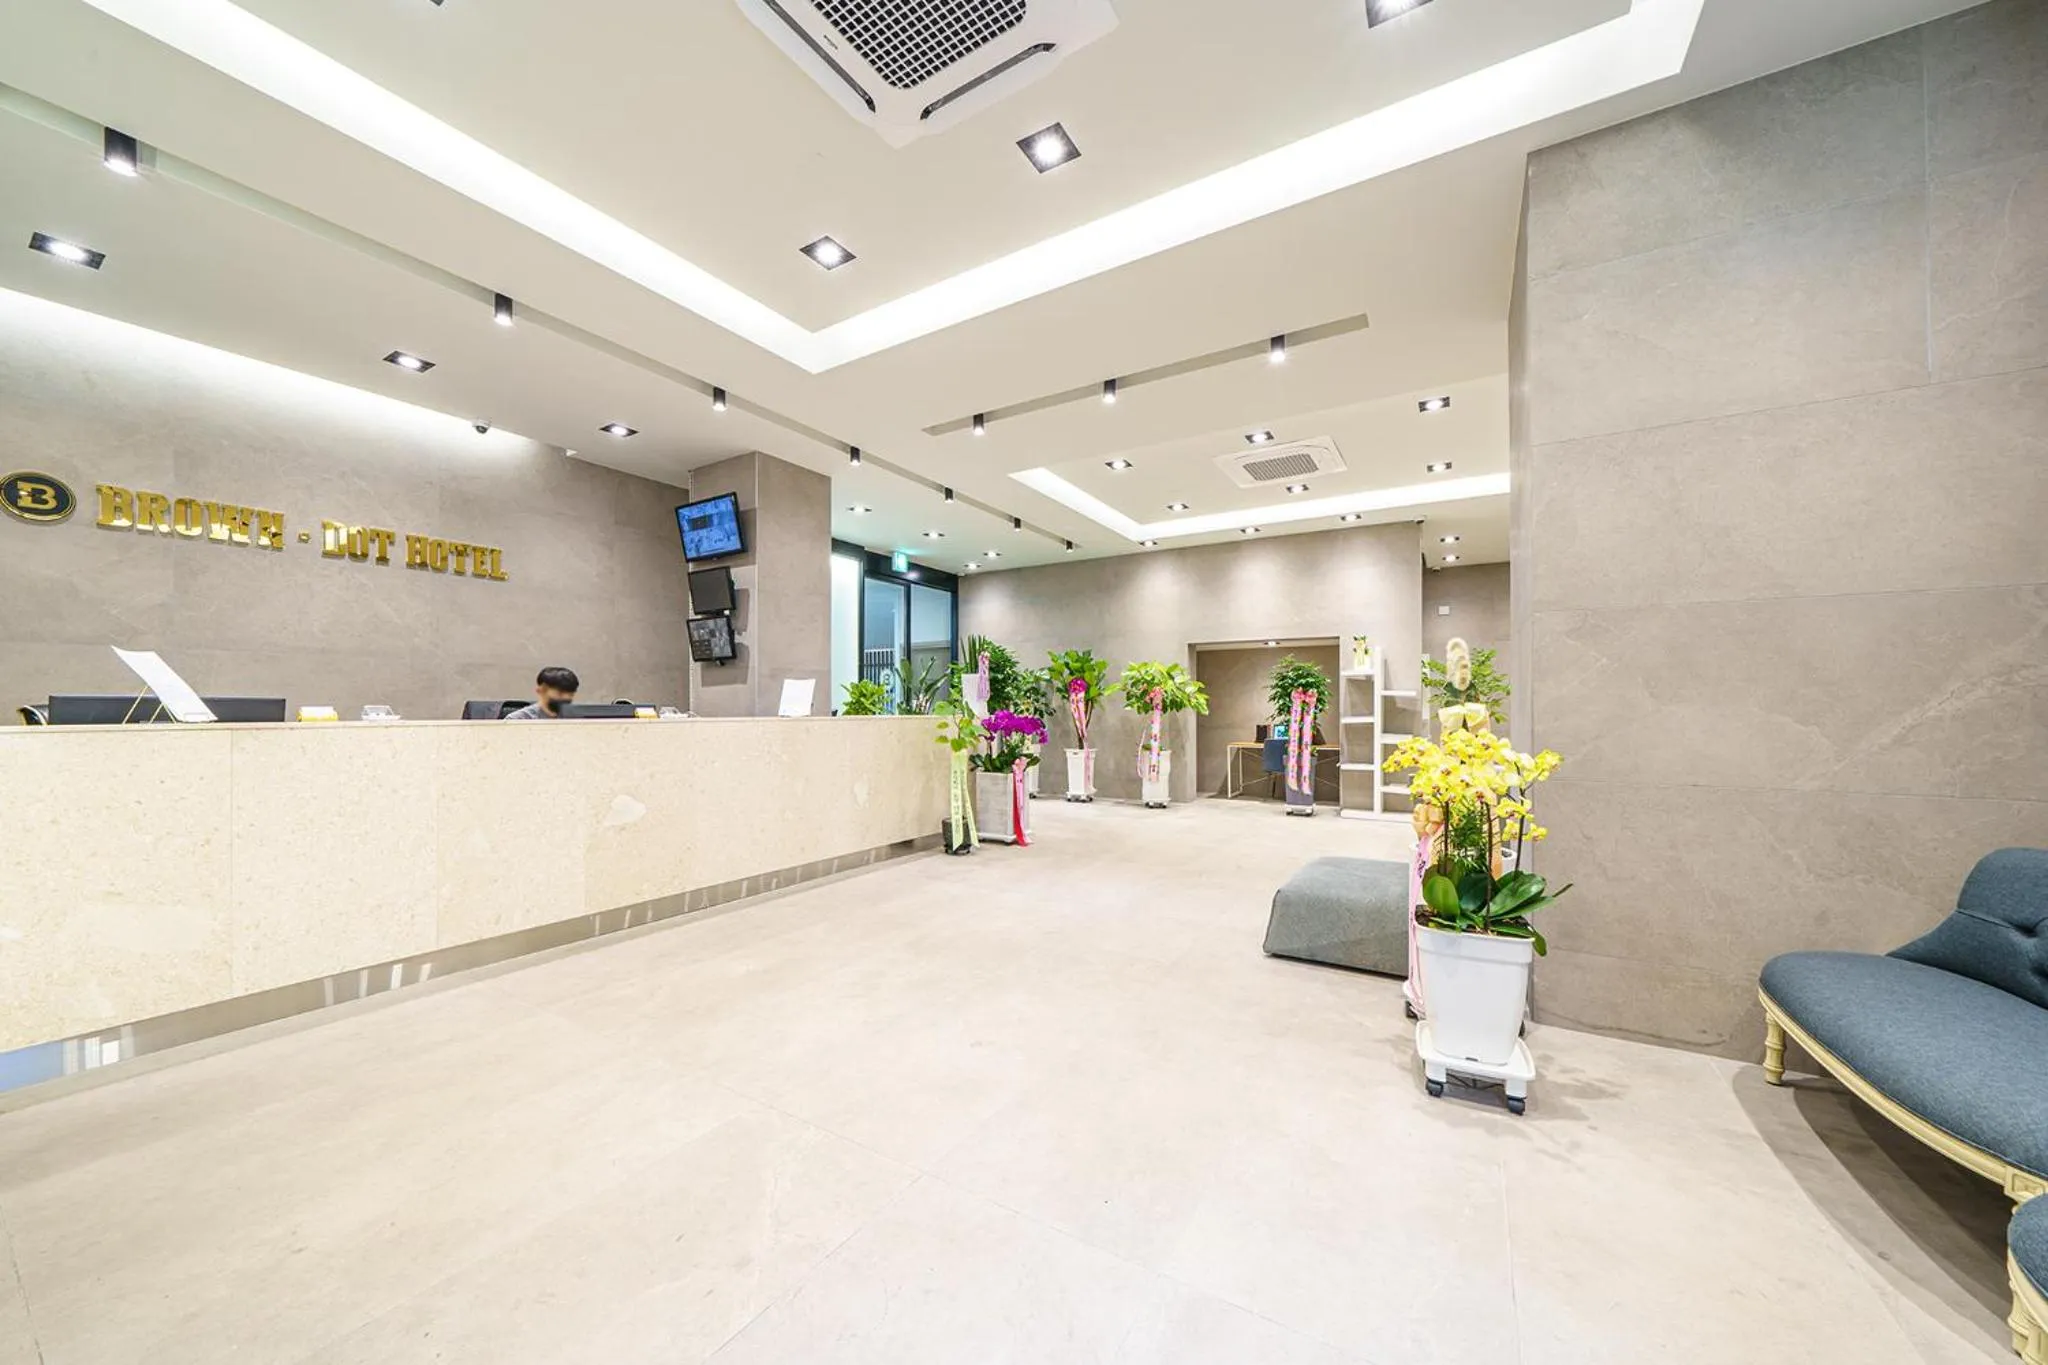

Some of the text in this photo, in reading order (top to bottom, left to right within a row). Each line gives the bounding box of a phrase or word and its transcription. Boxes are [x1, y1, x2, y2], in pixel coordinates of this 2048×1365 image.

[17, 480, 58, 510] B
[96, 484, 285, 551] BROWN
[321, 519, 396, 565] DOT
[404, 532, 508, 581] HOTEL
